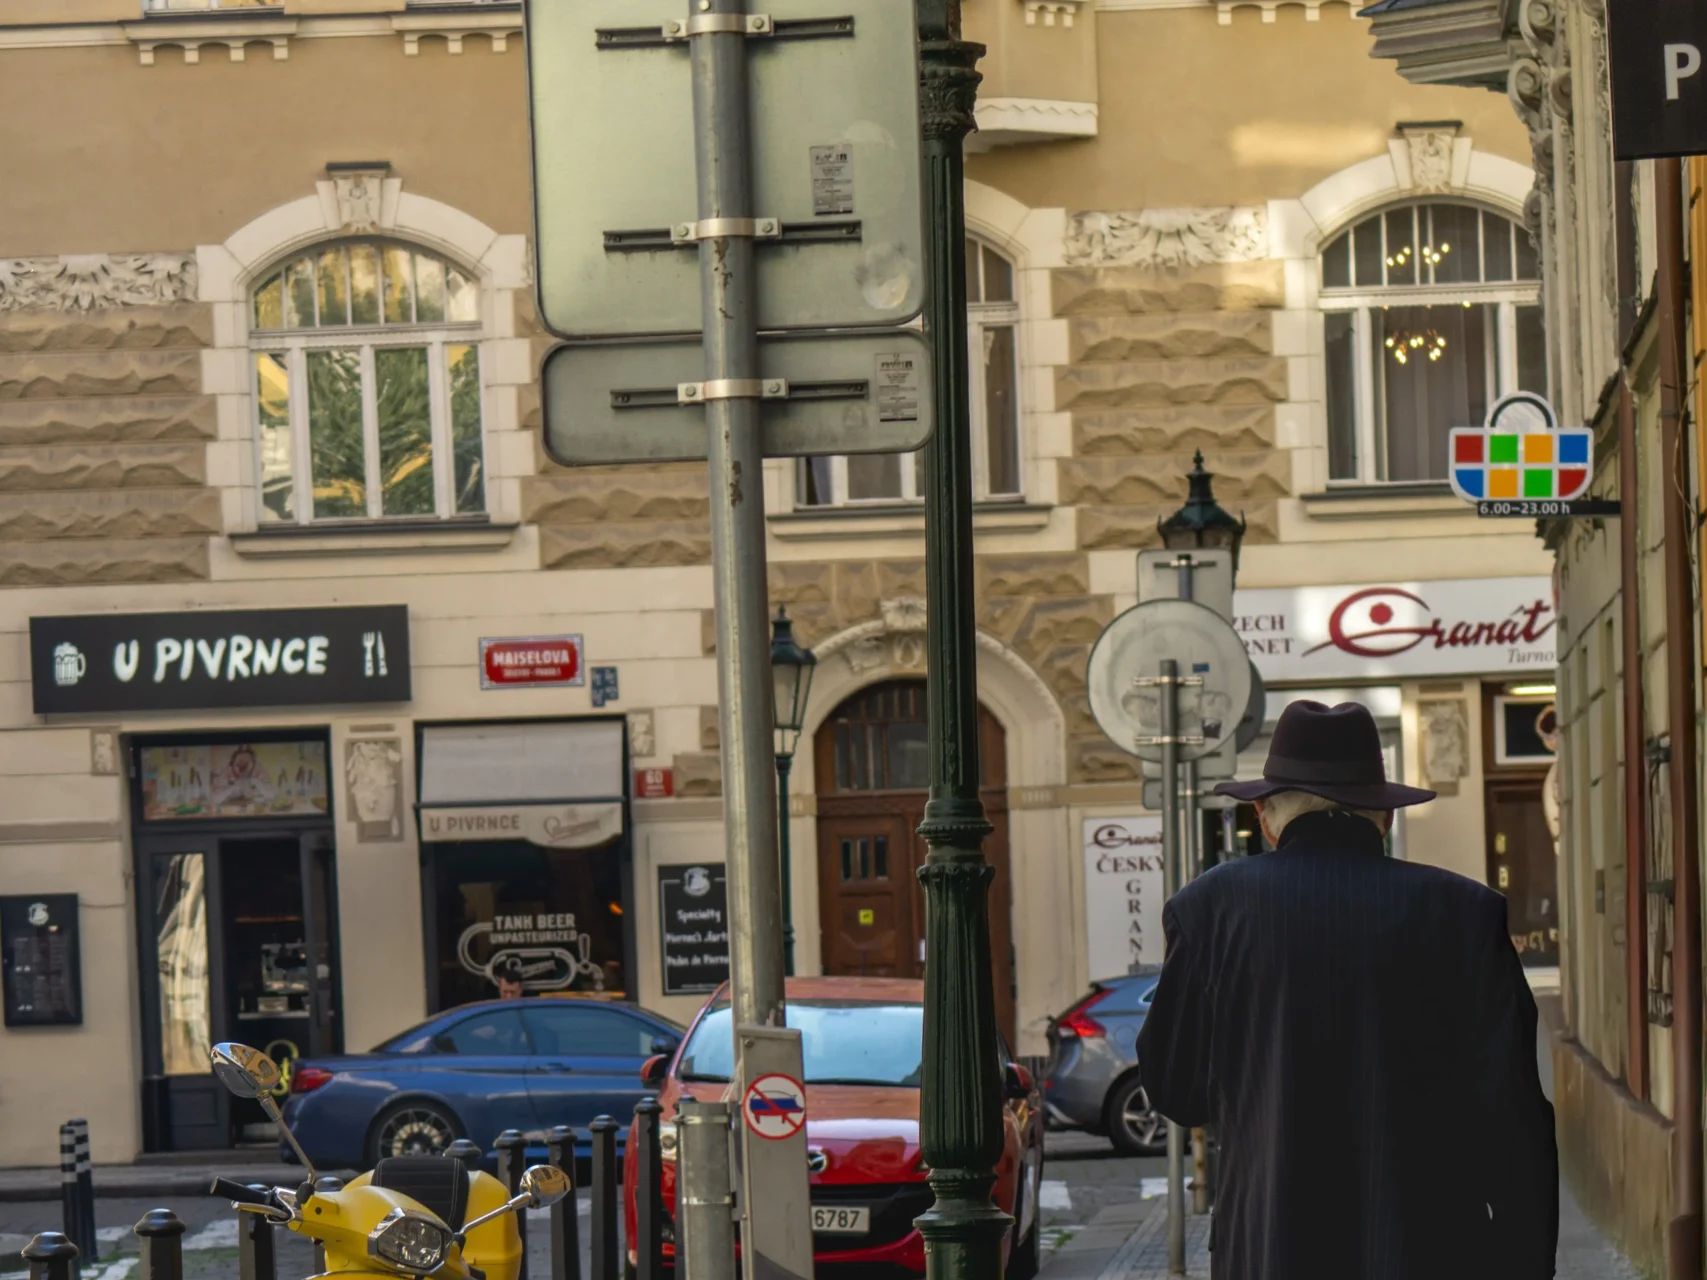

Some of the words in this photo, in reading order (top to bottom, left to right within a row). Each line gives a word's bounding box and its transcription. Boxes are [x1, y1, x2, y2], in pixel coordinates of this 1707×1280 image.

[1664, 43, 1702, 100] P
[1561, 502, 1570, 514] h
[113, 639, 140, 682] U
[153, 635, 329, 683] PIVRNCE
[492, 649, 570, 666] MAISELOVA
[429, 817, 441, 833] U
[447, 814, 520, 832] PIVRNCE
[495, 915, 533, 930] TANK
[537, 913, 576, 929] BEER
[815, 1209, 861, 1229] 6787
